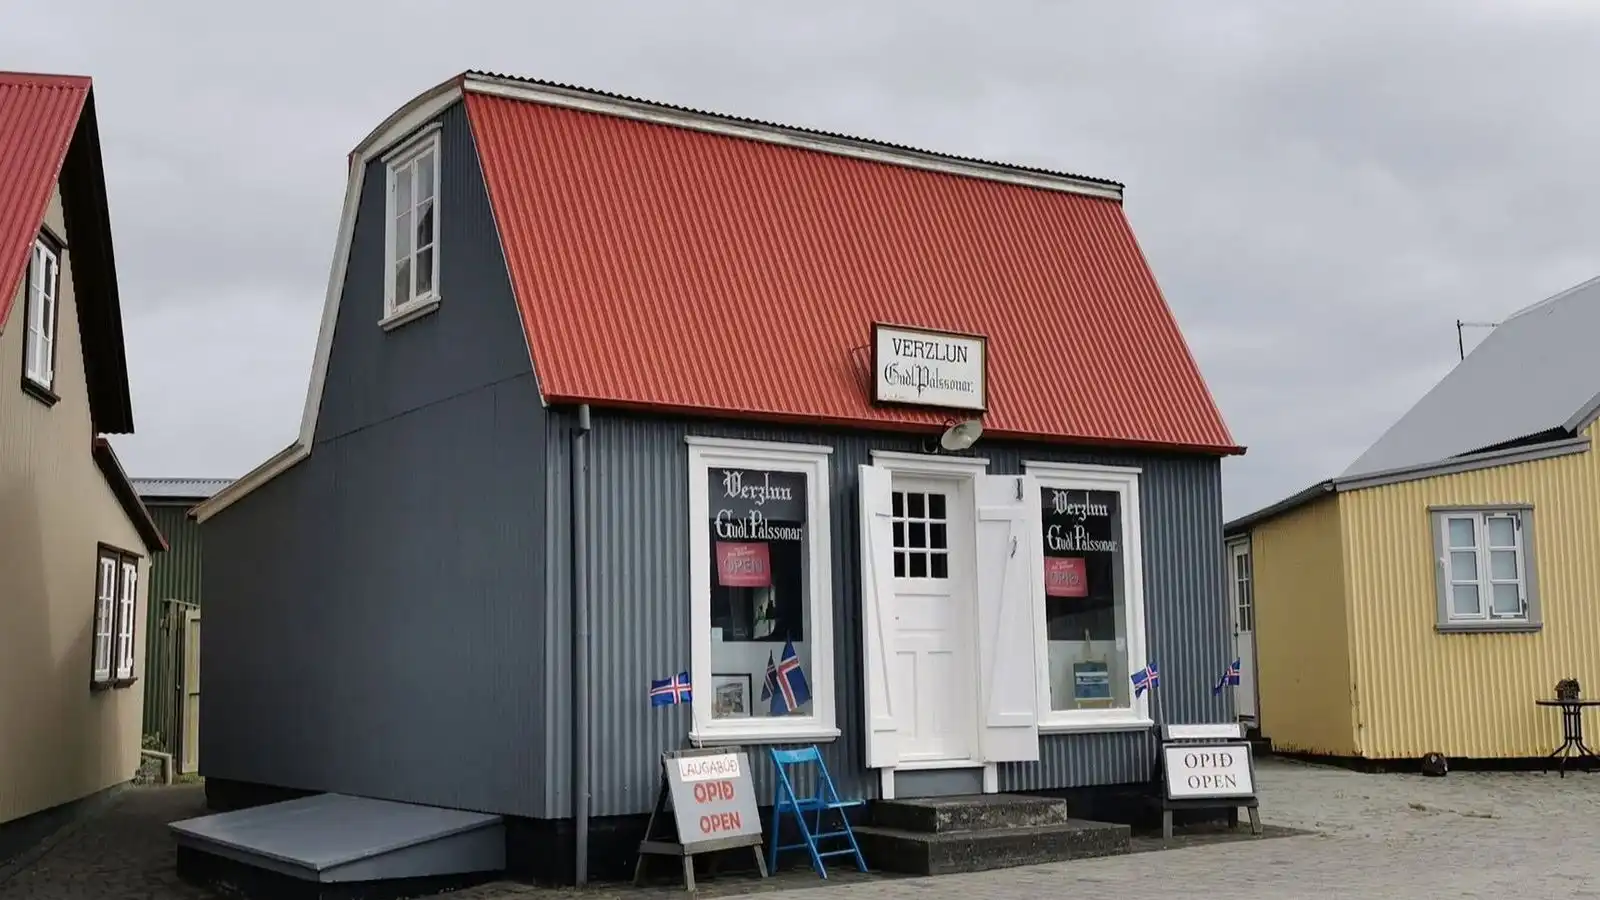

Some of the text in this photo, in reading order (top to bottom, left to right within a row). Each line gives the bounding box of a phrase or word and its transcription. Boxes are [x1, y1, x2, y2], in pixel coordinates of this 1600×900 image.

[892, 338, 967, 363] VERZLUN
[722, 469, 793, 506] Verzlun
[1052, 490, 1108, 521] Verzlun
[1184, 752, 1233, 768] OPIÐ
[694, 780, 735, 804] OPIÐ
[1188, 774, 1237, 789] OPEN
[700, 811, 742, 834] OPEN
